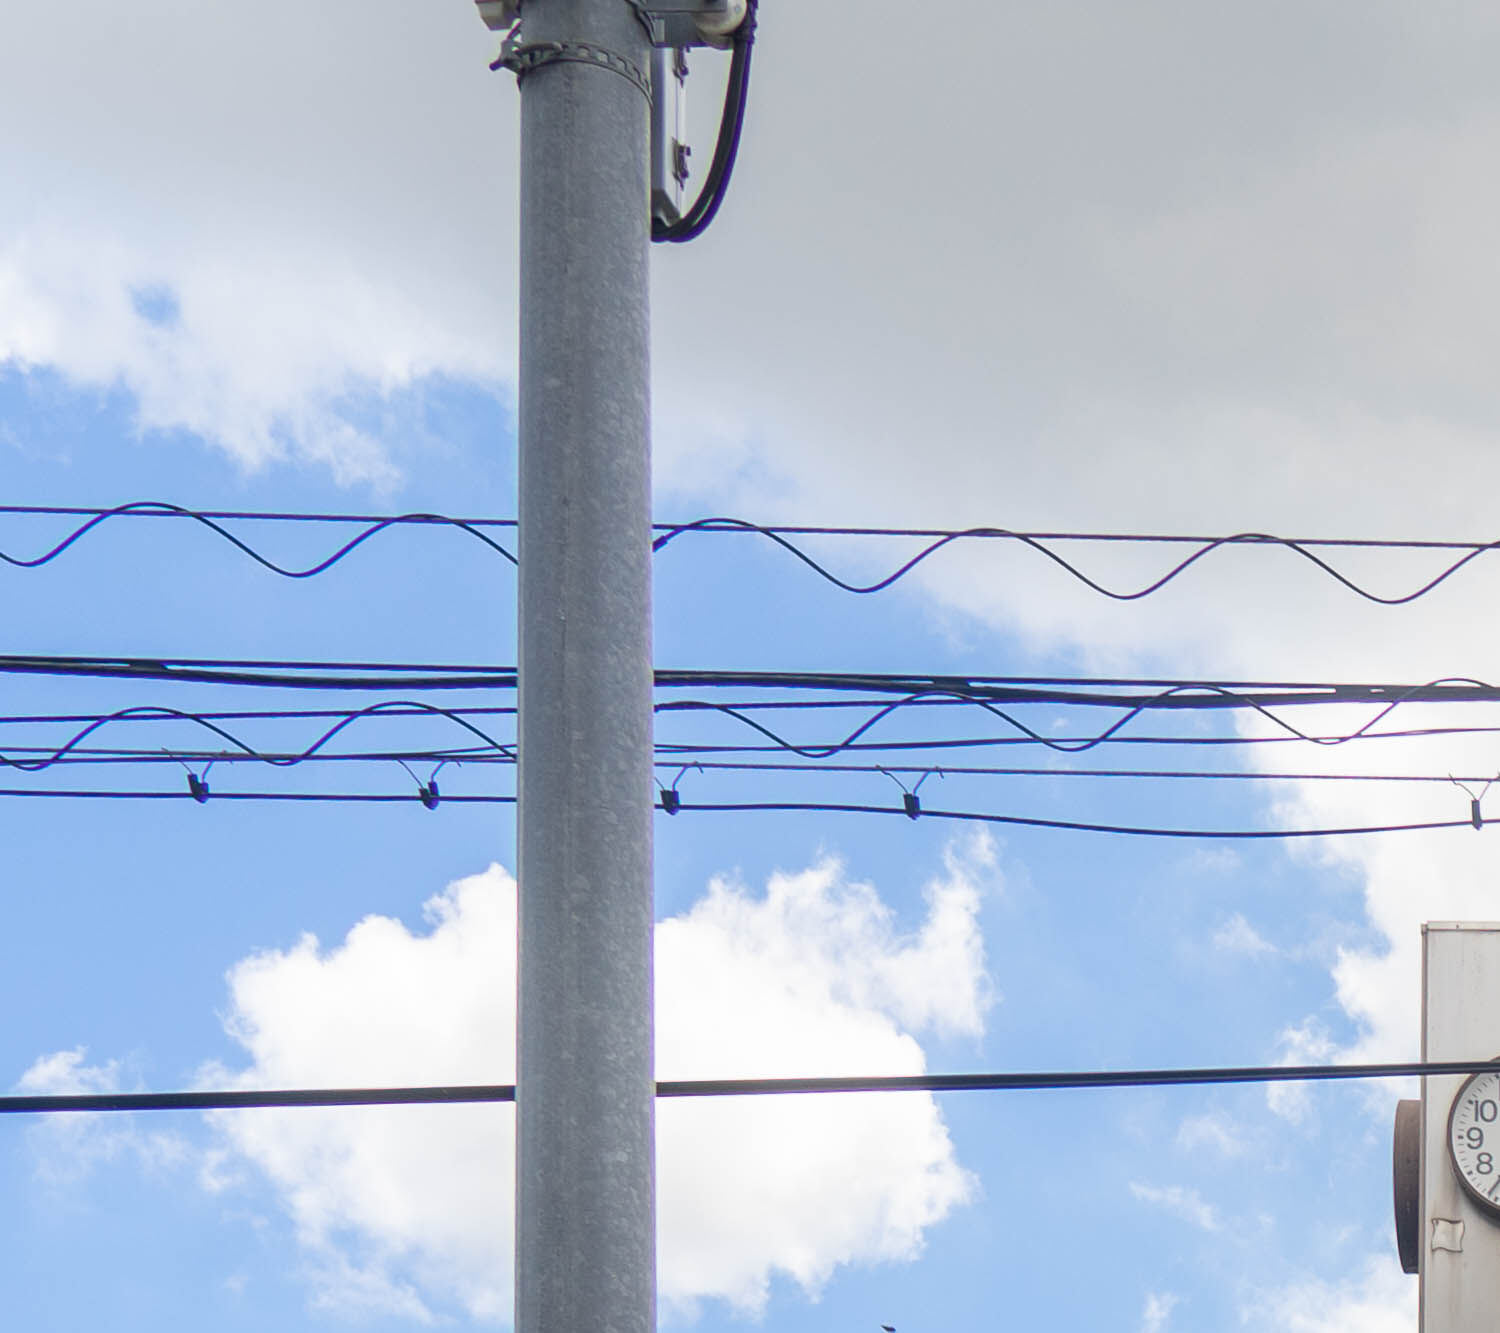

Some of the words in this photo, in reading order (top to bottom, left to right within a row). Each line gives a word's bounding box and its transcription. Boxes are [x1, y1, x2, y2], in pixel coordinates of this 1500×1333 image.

[1474, 1100, 1498, 1123] 10
[1466, 1126, 1484, 1150] 9
[1476, 1152, 1494, 1175] 8
